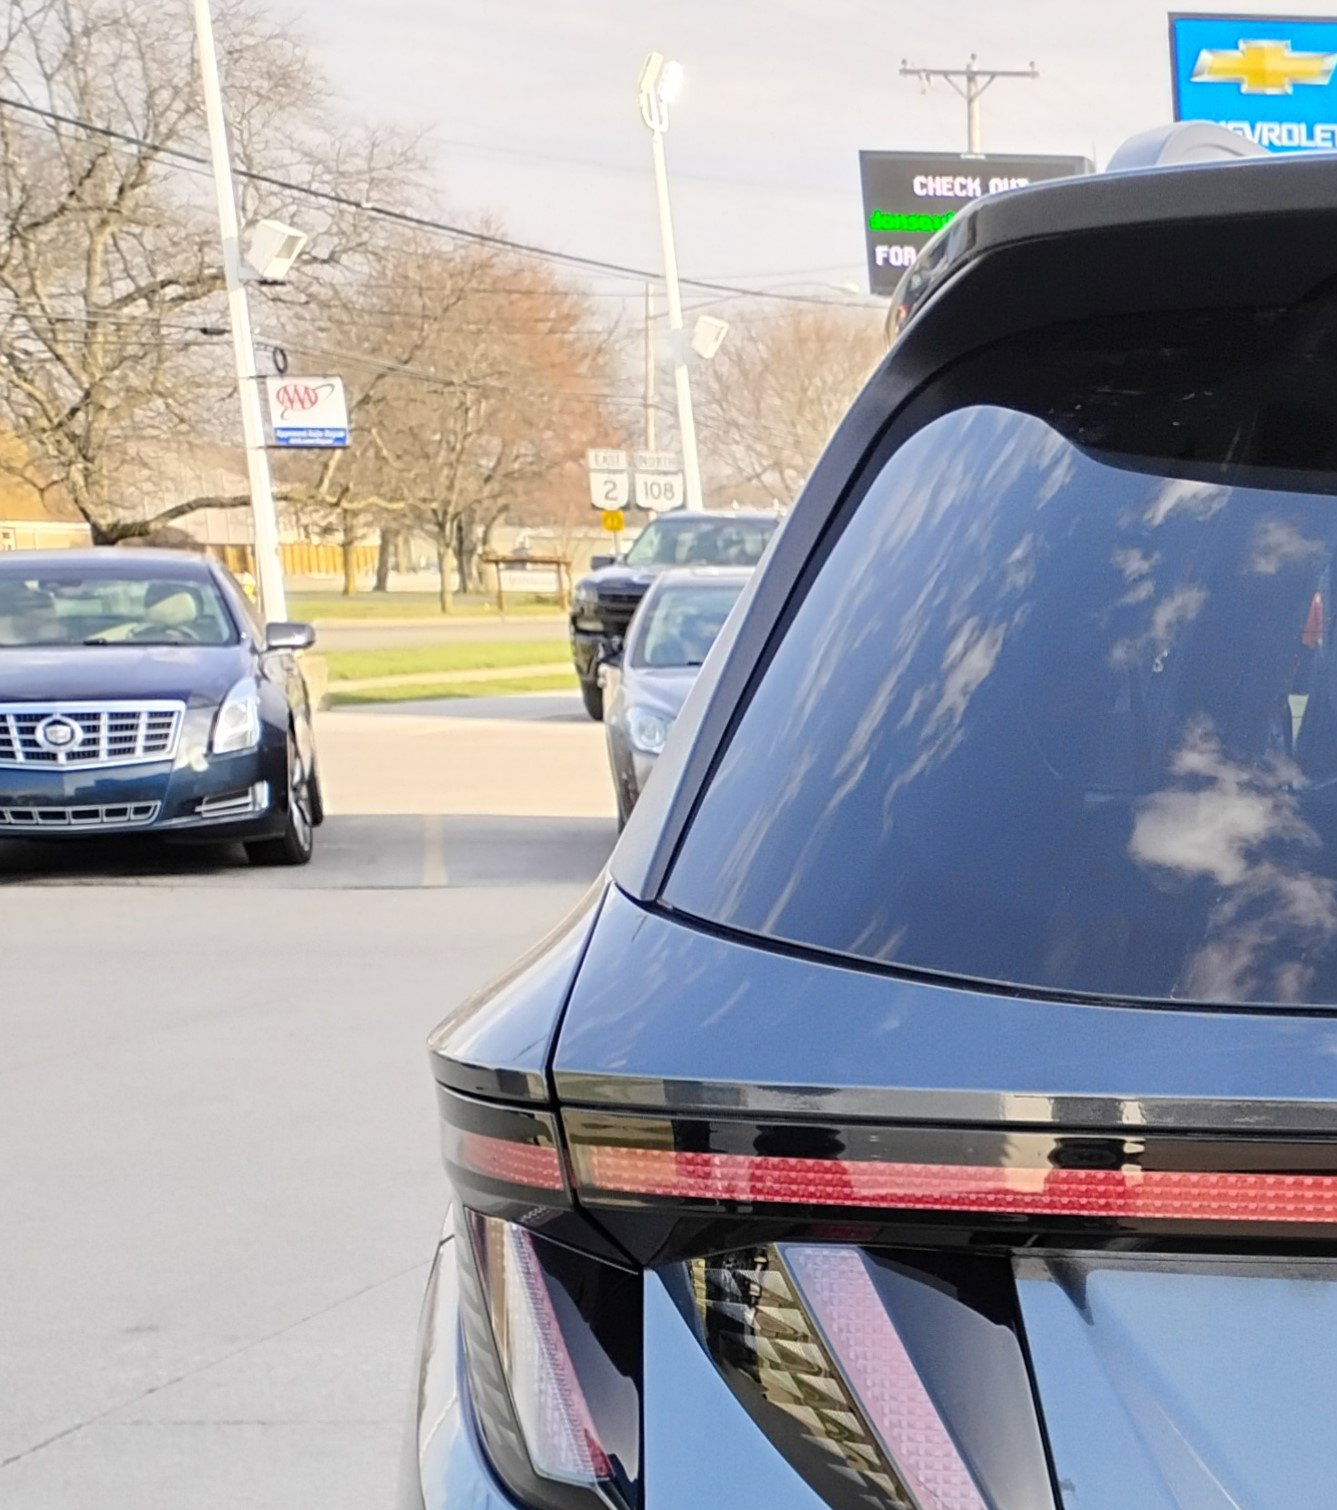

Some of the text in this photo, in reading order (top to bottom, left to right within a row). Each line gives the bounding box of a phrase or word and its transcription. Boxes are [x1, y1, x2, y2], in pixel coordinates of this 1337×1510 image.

[913, 175, 981, 197] CHECK
[875, 245, 917, 267] FOR
[603, 480, 618, 501] 2
[643, 481, 676, 501] 108
